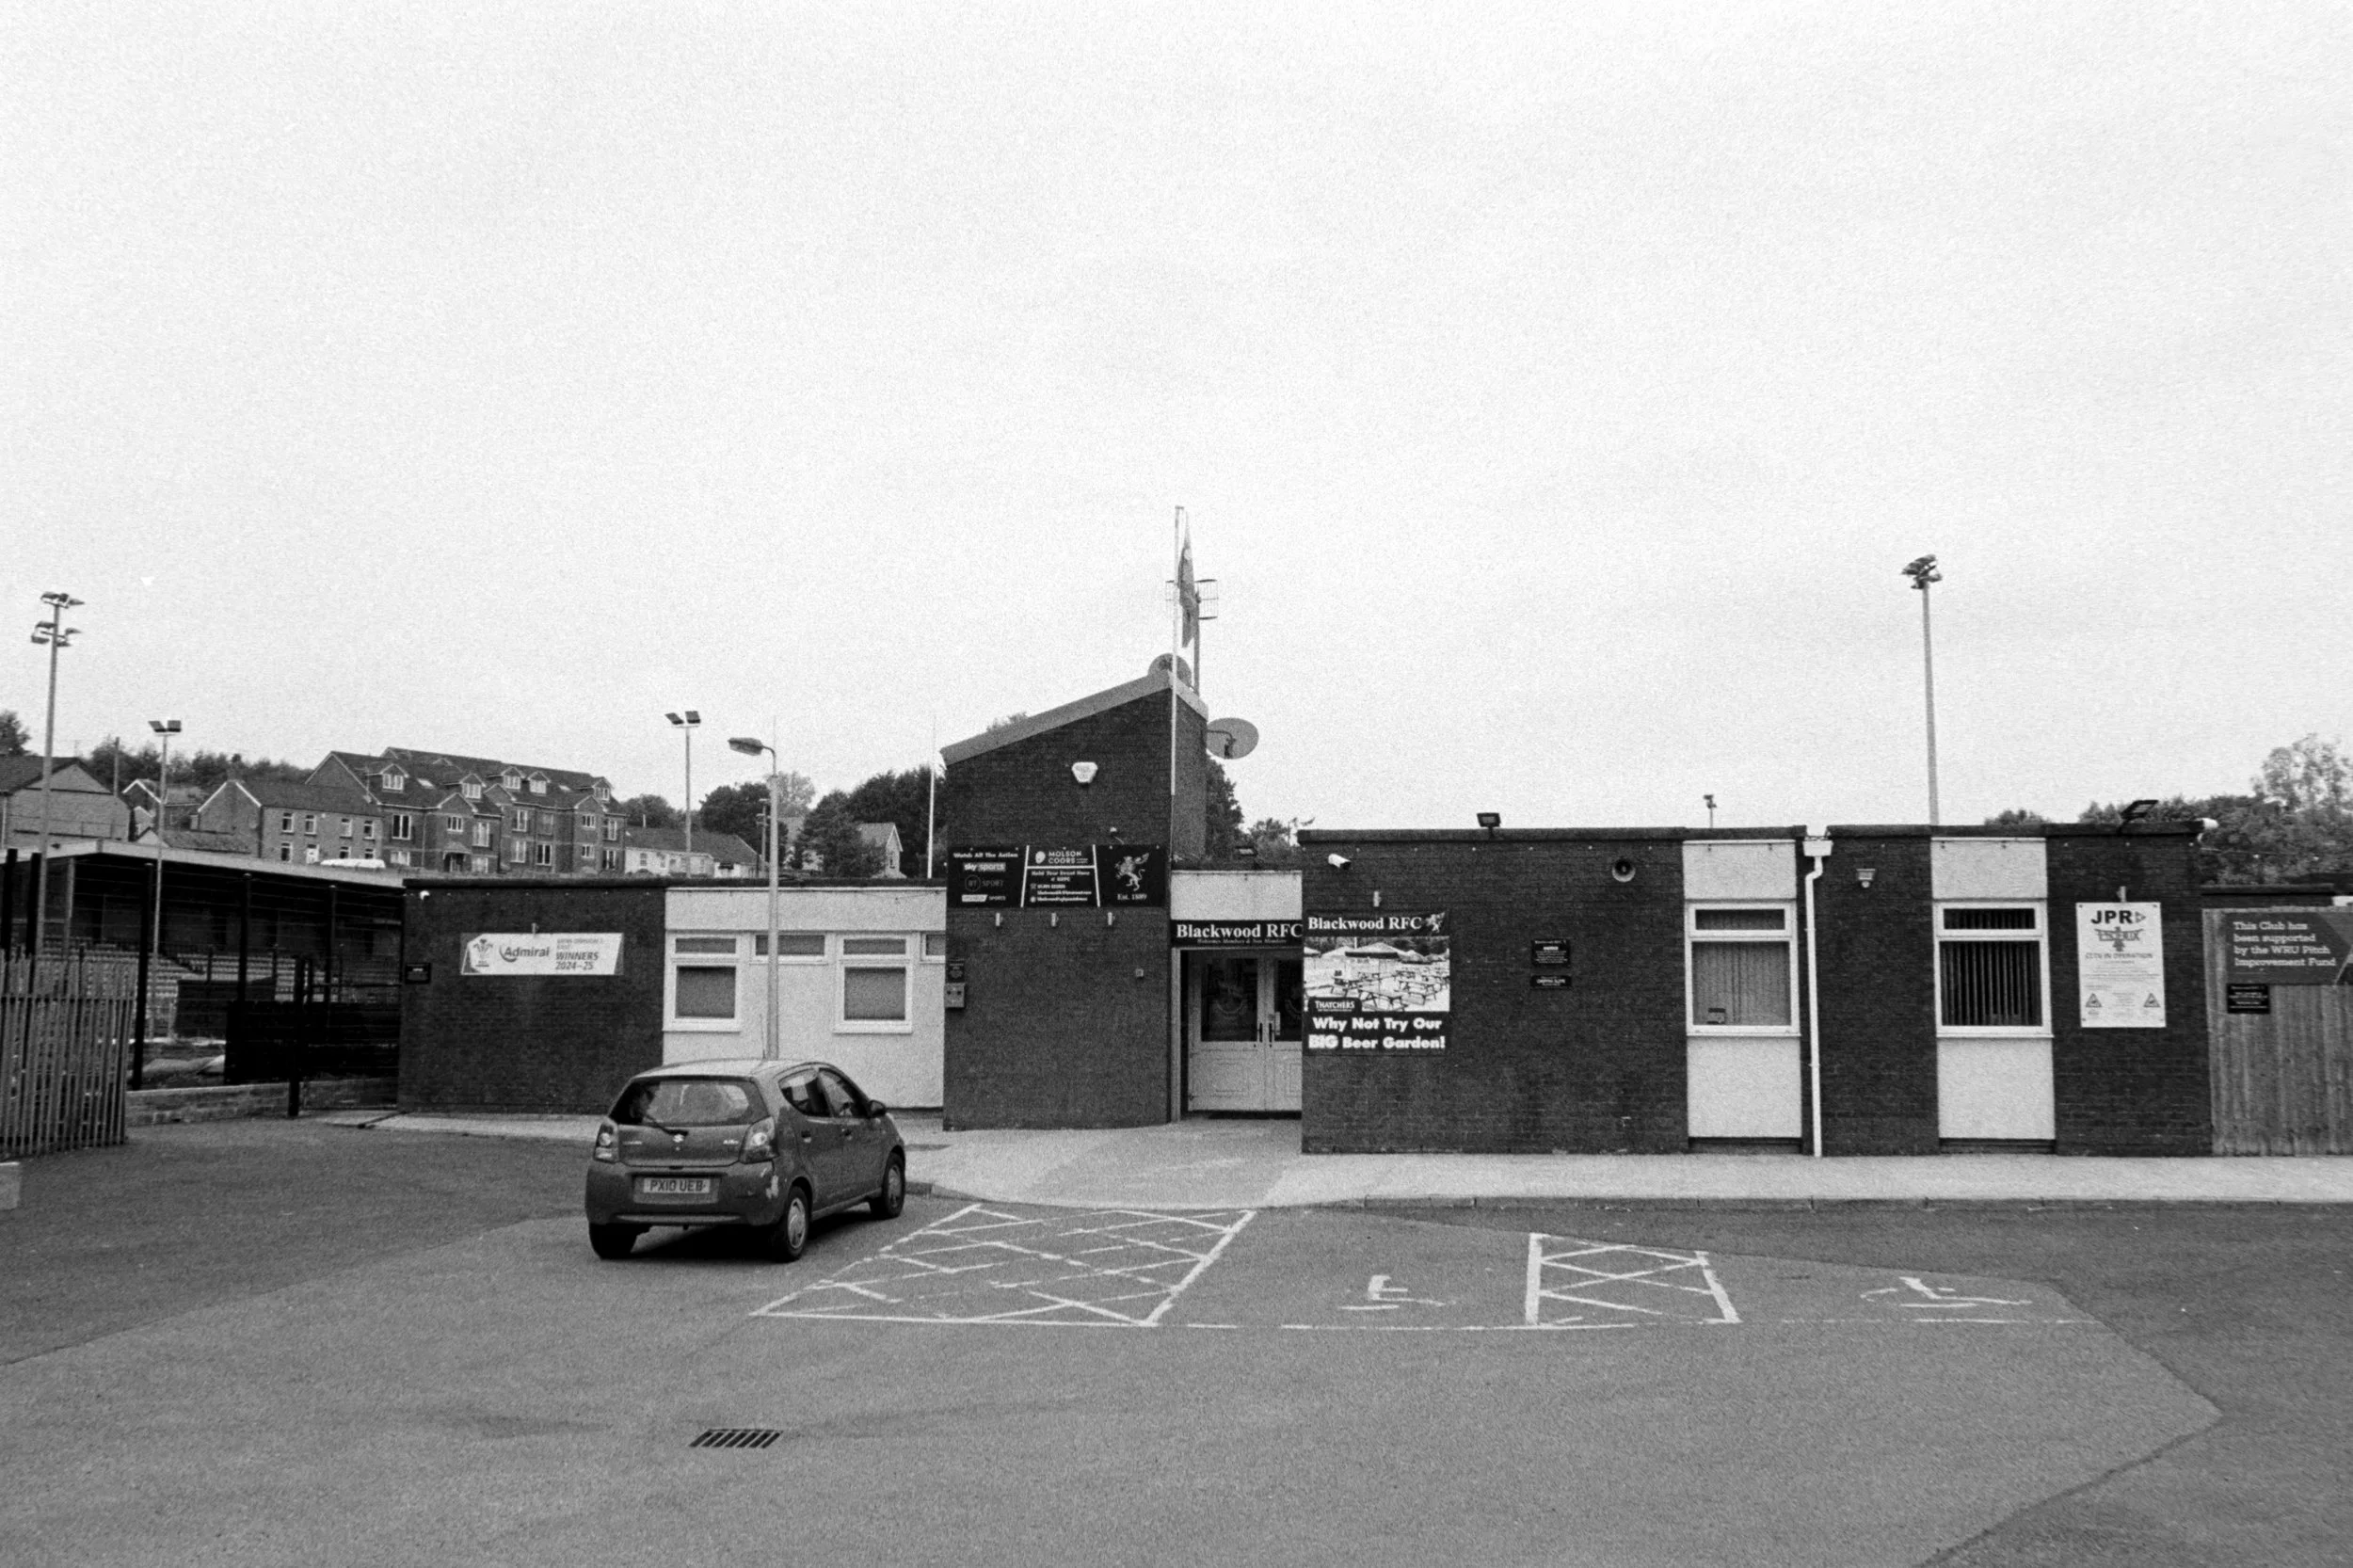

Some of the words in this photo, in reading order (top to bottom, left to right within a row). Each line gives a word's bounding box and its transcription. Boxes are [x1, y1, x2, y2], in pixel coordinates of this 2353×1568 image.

[964, 862, 977, 872] sky
[978, 862, 1006, 872] sports
[2090, 910, 2133, 924] JPR
[1307, 917, 1385, 930] Blackwood
[1388, 917, 1422, 930] RFC
[2233, 921, 2257, 931] This
[2259, 921, 2285, 931] Club
[2288, 921, 2308, 931] has
[1176, 923, 1261, 938] Blackwood
[1266, 923, 1304, 938] RFC
[2262, 933, 2316, 945] supported
[504, 946, 550, 958] Admiral
[555, 952, 599, 960] WINNERS
[2233, 945, 2249, 956] by
[2250, 945, 2268, 954] the
[2270, 945, 2299, 954] WRU
[2308, 957, 2336, 967] Fund
[1315, 1000, 1355, 1009] THATCHERS
[1312, 1016, 1347, 1032] Why
[1352, 1016, 1380, 1030] Not
[1384, 1016, 1408, 1032] Try
[1413, 1017, 1443, 1030] Our
[1308, 1034, 1338, 1048] BIG
[1342, 1036, 1378, 1048] Beer
[1383, 1035, 1446, 1049] Garden!
